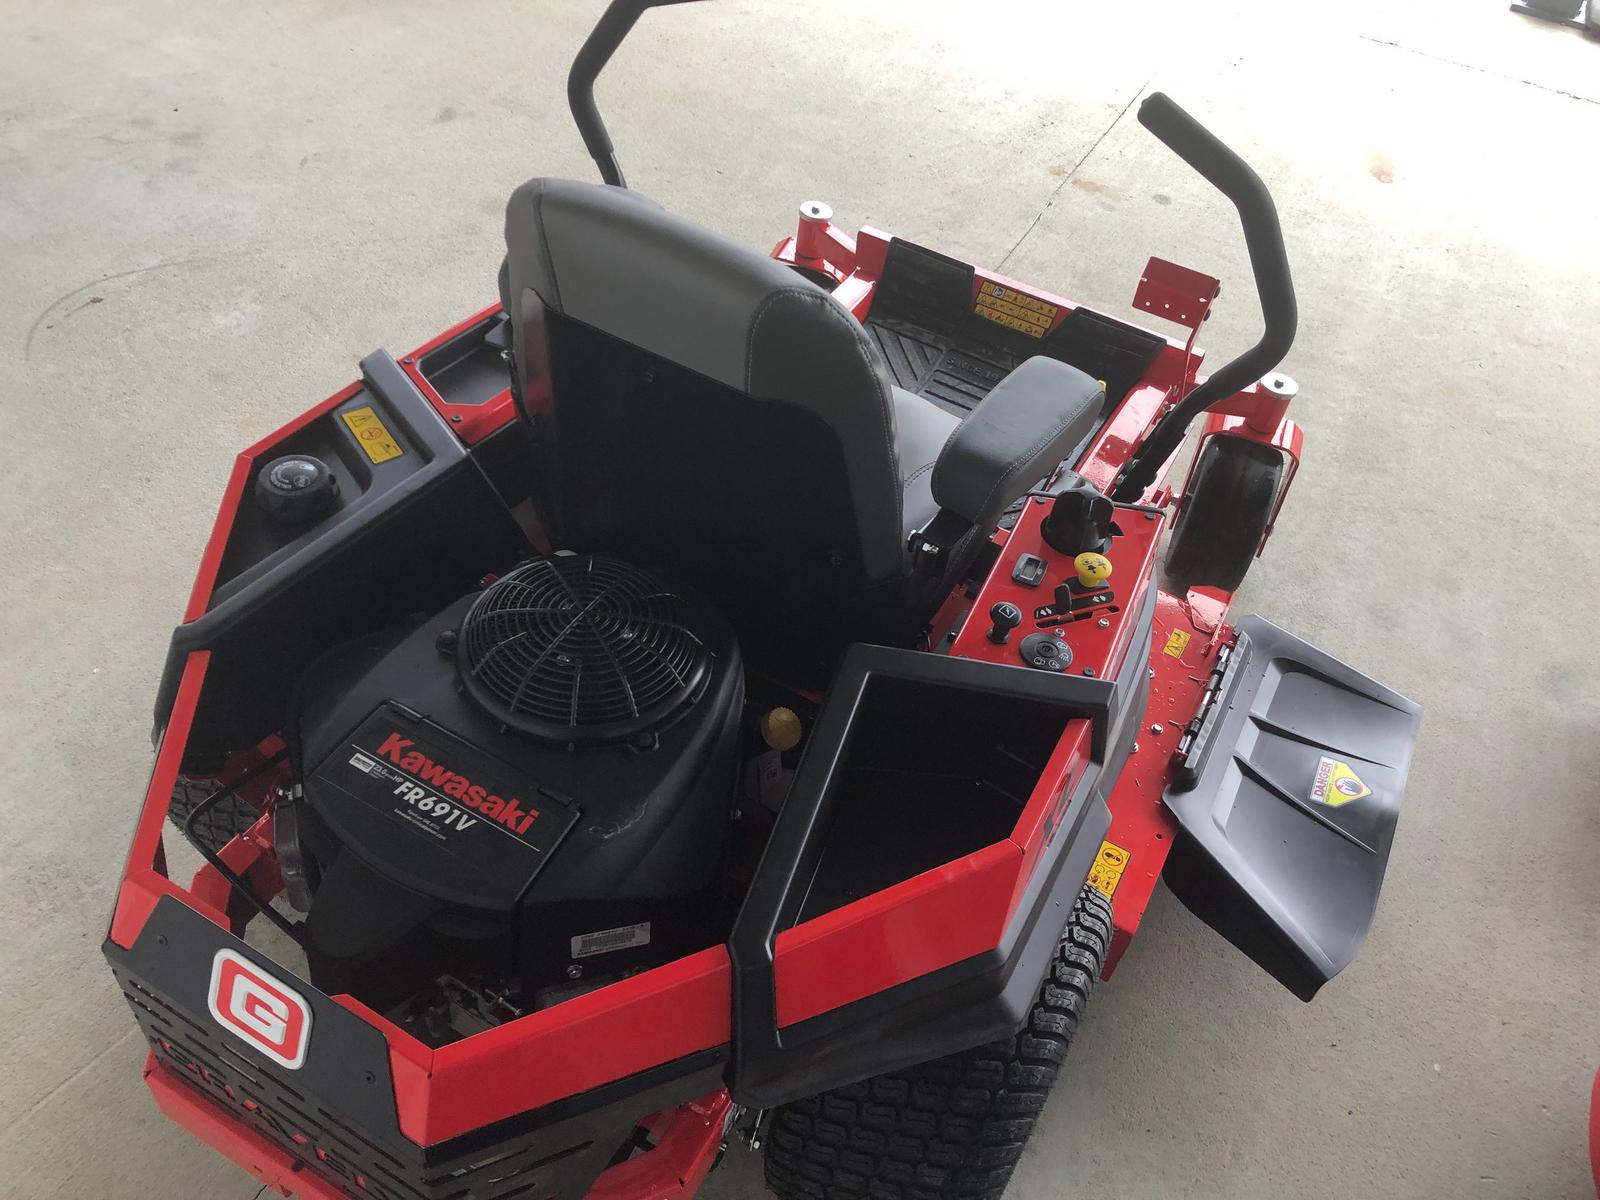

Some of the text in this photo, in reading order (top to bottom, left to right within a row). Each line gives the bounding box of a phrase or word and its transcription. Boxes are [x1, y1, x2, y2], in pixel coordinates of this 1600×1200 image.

[945, 358, 982, 377] SINCE
[376, 732, 539, 835] Kawasaki
[1313, 761, 1333, 797] DANGER
[393, 781, 478, 832] FR691V
[229, 973, 289, 1046] G
